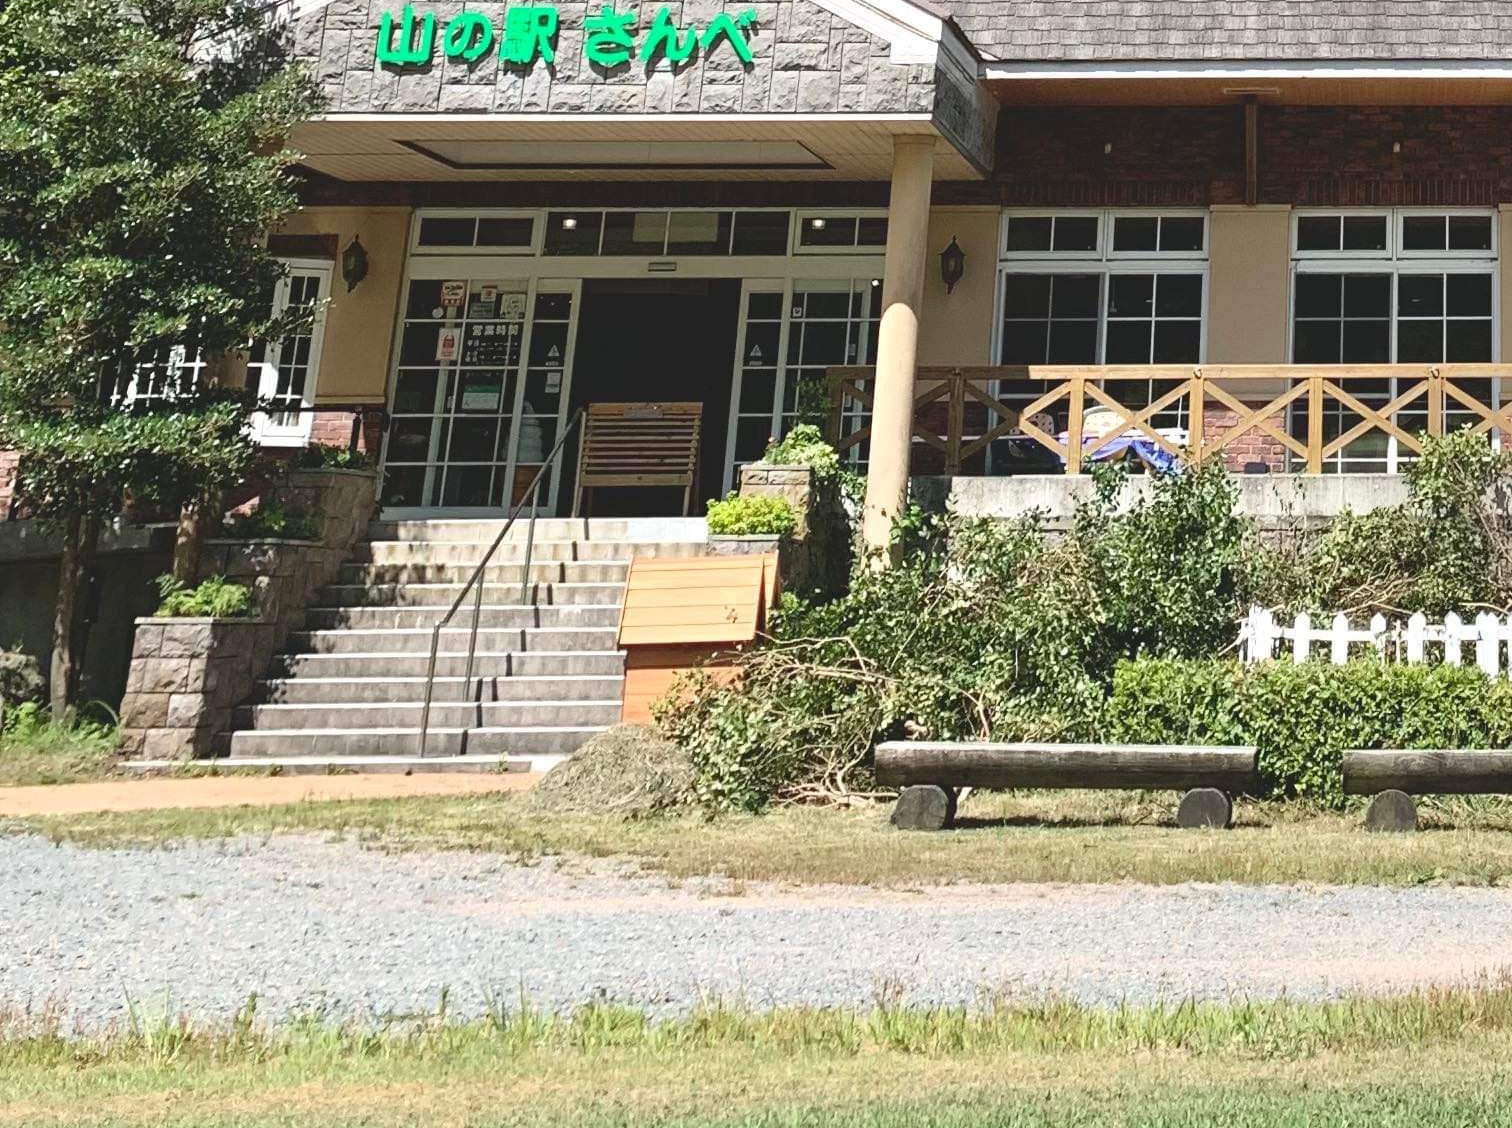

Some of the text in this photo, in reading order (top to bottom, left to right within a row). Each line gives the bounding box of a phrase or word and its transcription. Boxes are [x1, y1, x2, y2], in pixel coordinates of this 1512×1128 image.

[375, 3, 757, 65] 山の駅 さんべ
